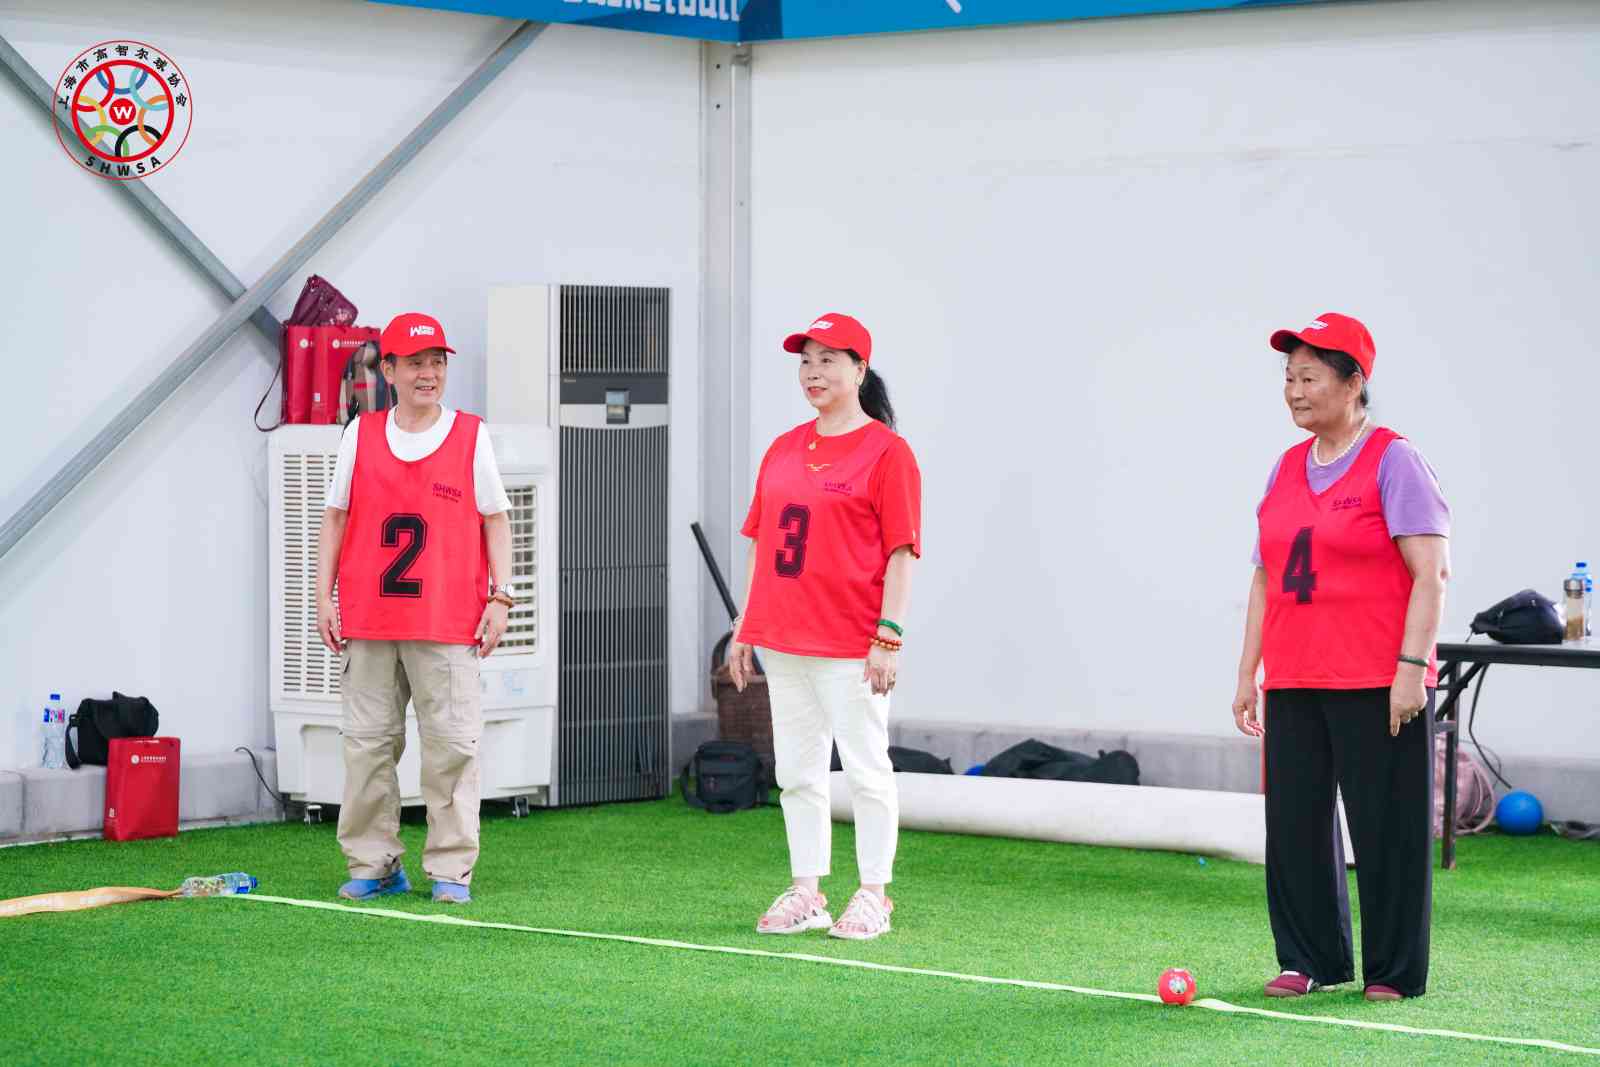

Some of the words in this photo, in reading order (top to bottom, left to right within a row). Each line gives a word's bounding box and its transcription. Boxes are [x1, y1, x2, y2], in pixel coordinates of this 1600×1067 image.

[379, 512, 428, 598] 2
[774, 503, 811, 579] 3
[1282, 526, 1317, 605] 4
